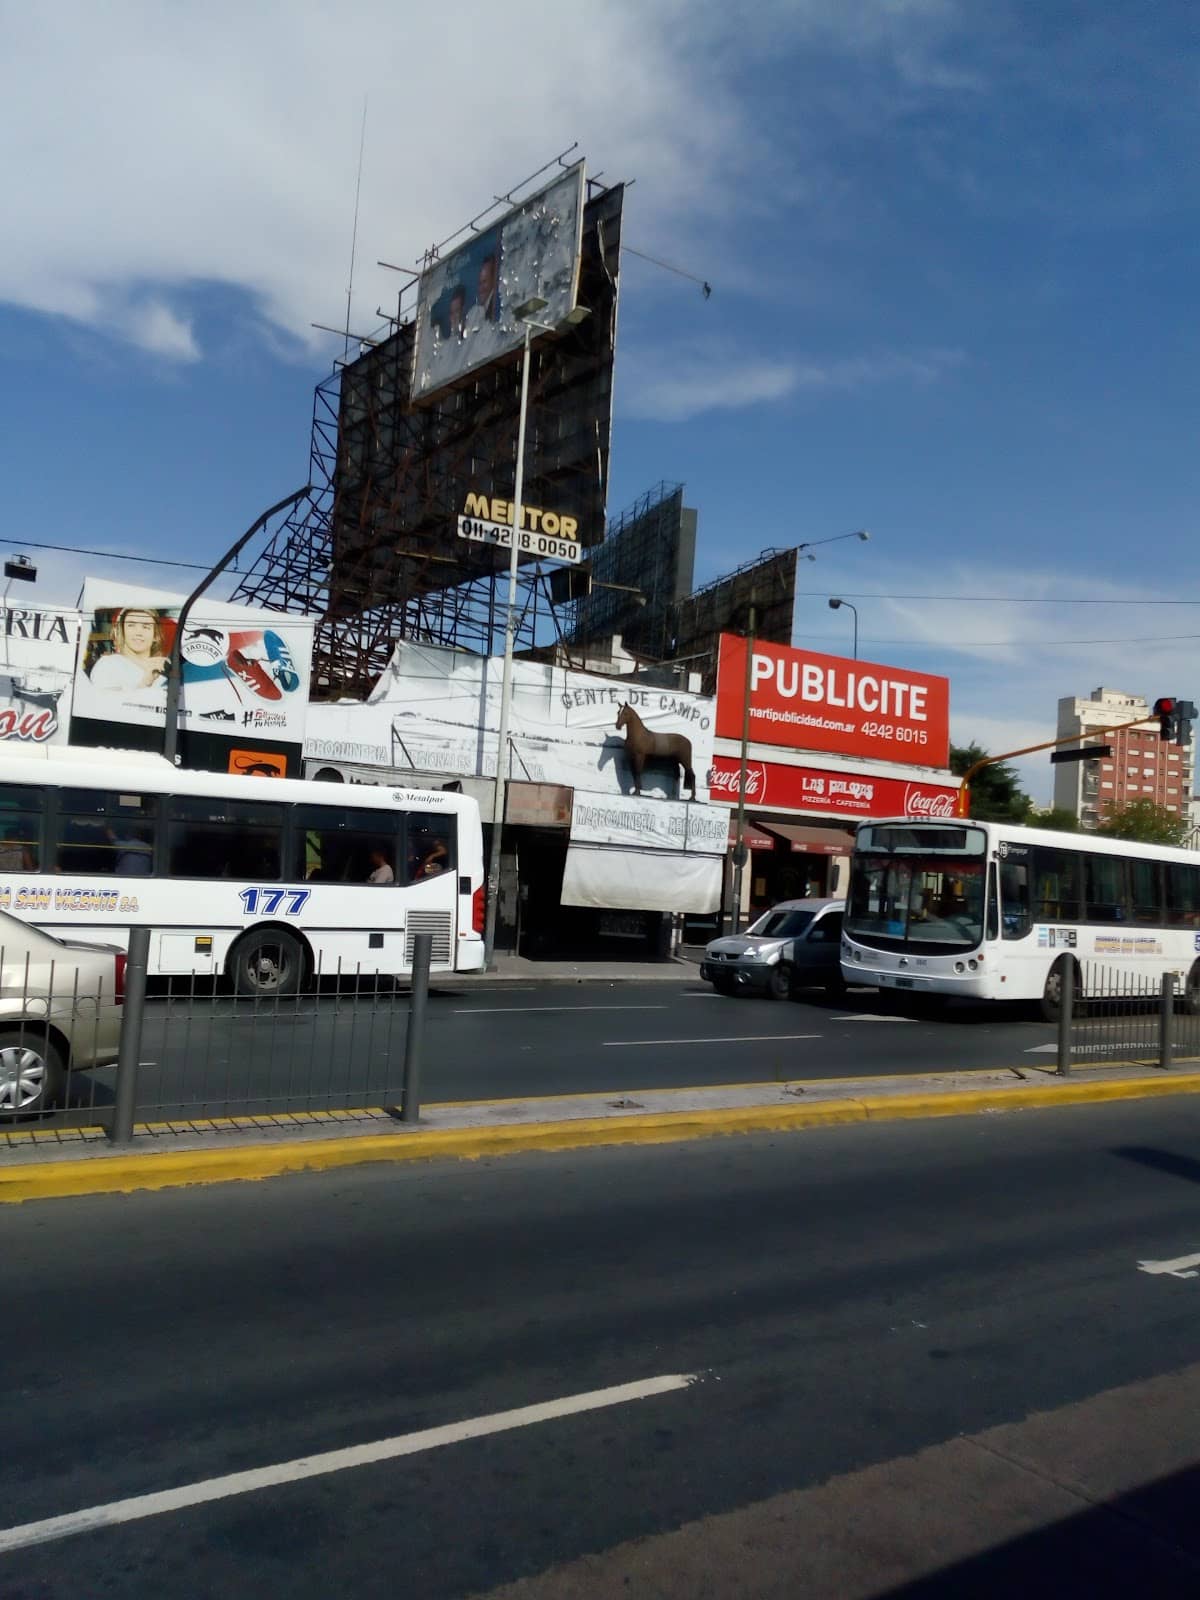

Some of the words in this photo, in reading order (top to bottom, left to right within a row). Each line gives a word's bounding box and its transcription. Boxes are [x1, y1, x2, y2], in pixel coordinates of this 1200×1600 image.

[464, 492, 578, 541] MENTOR
[0, 608, 69, 643] RIA
[186, 643, 219, 657] JAGUAR
[751, 653, 928, 721] PUBLICITE
[561, 687, 619, 709] GENTE
[629, 688, 650, 707] DE
[659, 694, 711, 730] CAMPO
[861, 721, 893, 740] 4242
[896, 727, 928, 745] 6015
[15, 886, 53, 911] SAN
[55, 888, 120, 912] VICENTE
[239, 886, 312, 916] 177
